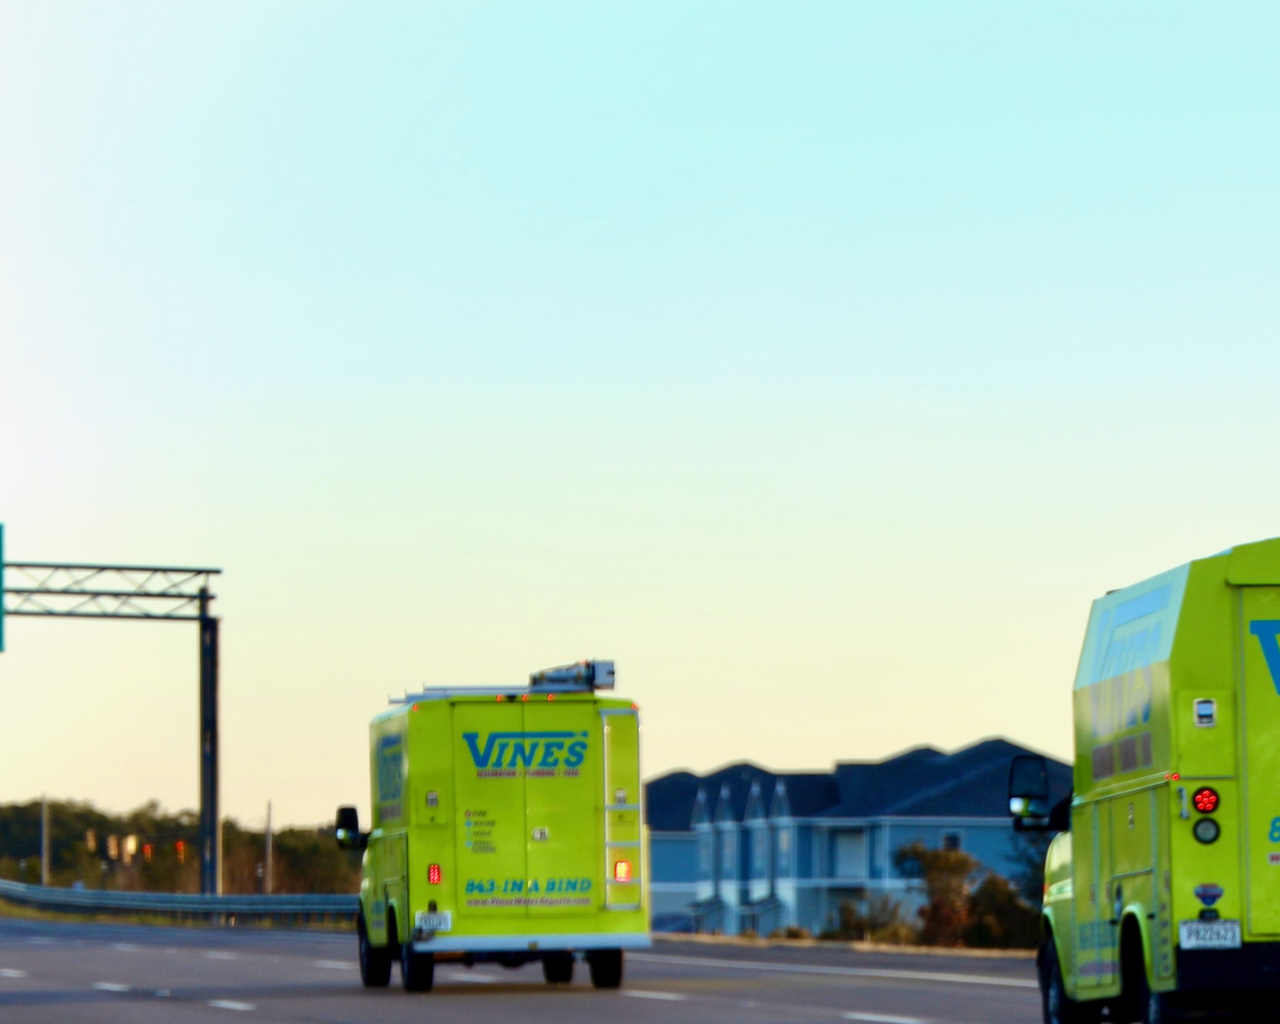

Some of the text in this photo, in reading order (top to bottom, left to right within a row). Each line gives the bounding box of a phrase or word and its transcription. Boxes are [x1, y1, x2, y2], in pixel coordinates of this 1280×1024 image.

[462, 731, 588, 768] VINES
[528, 879, 541, 892] A
[545, 878, 592, 892] BIND
